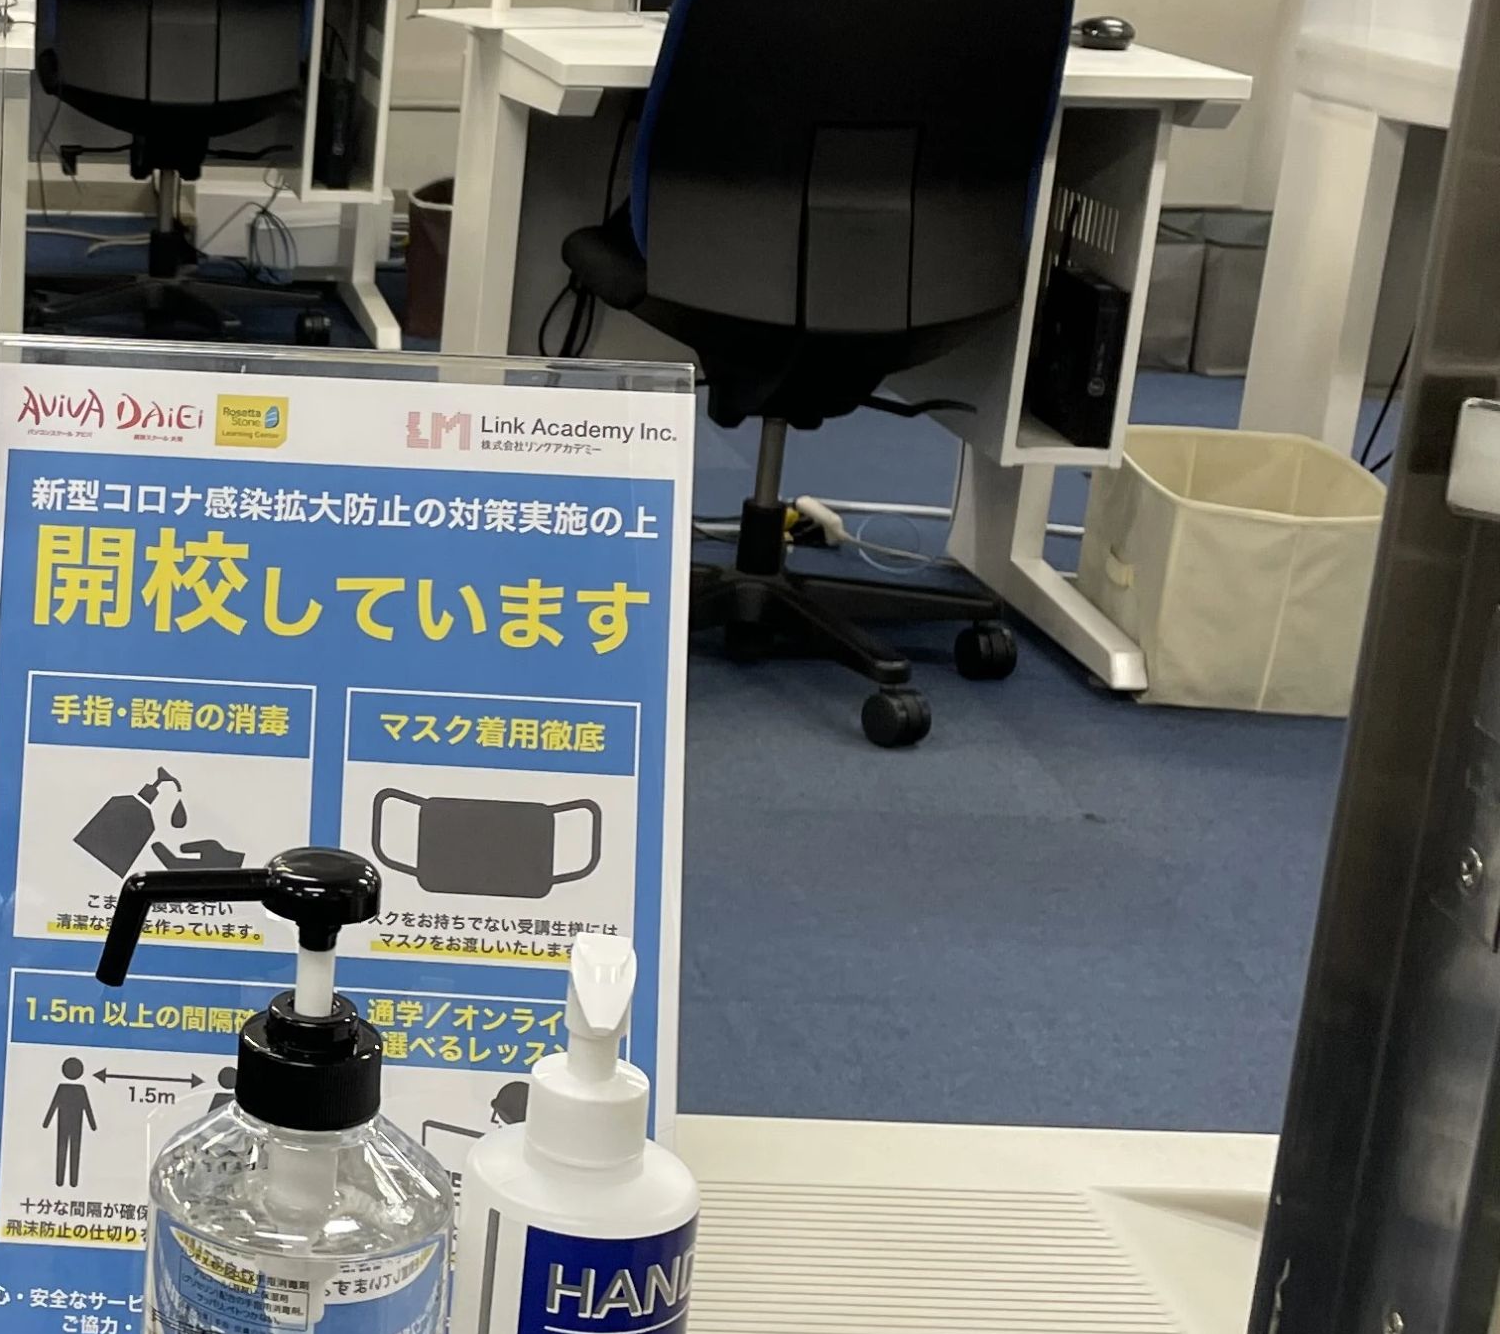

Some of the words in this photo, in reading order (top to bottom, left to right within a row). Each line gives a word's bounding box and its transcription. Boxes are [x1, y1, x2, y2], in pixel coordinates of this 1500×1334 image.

[221, 406, 262, 418] Rosetta
[480, 415, 525, 436] Link
[530, 418, 635, 444] Academy
[640, 422, 678, 442] Inc.
[480, 439, 603, 455] 株式会社リンクアカデミー
[30, 476, 660, 542] 新型コロナ感染拡大防止の対策実施の上
[32, 523, 652, 655] 開校しています
[49, 694, 292, 738] 手指・設備の消毒
[378, 711, 607, 754] マスク着用徹底
[25, 996, 96, 1024] 1.5m
[381, 1030, 565, 1066] 選べるレッス
[127, 1085, 177, 1105] 1.5m
